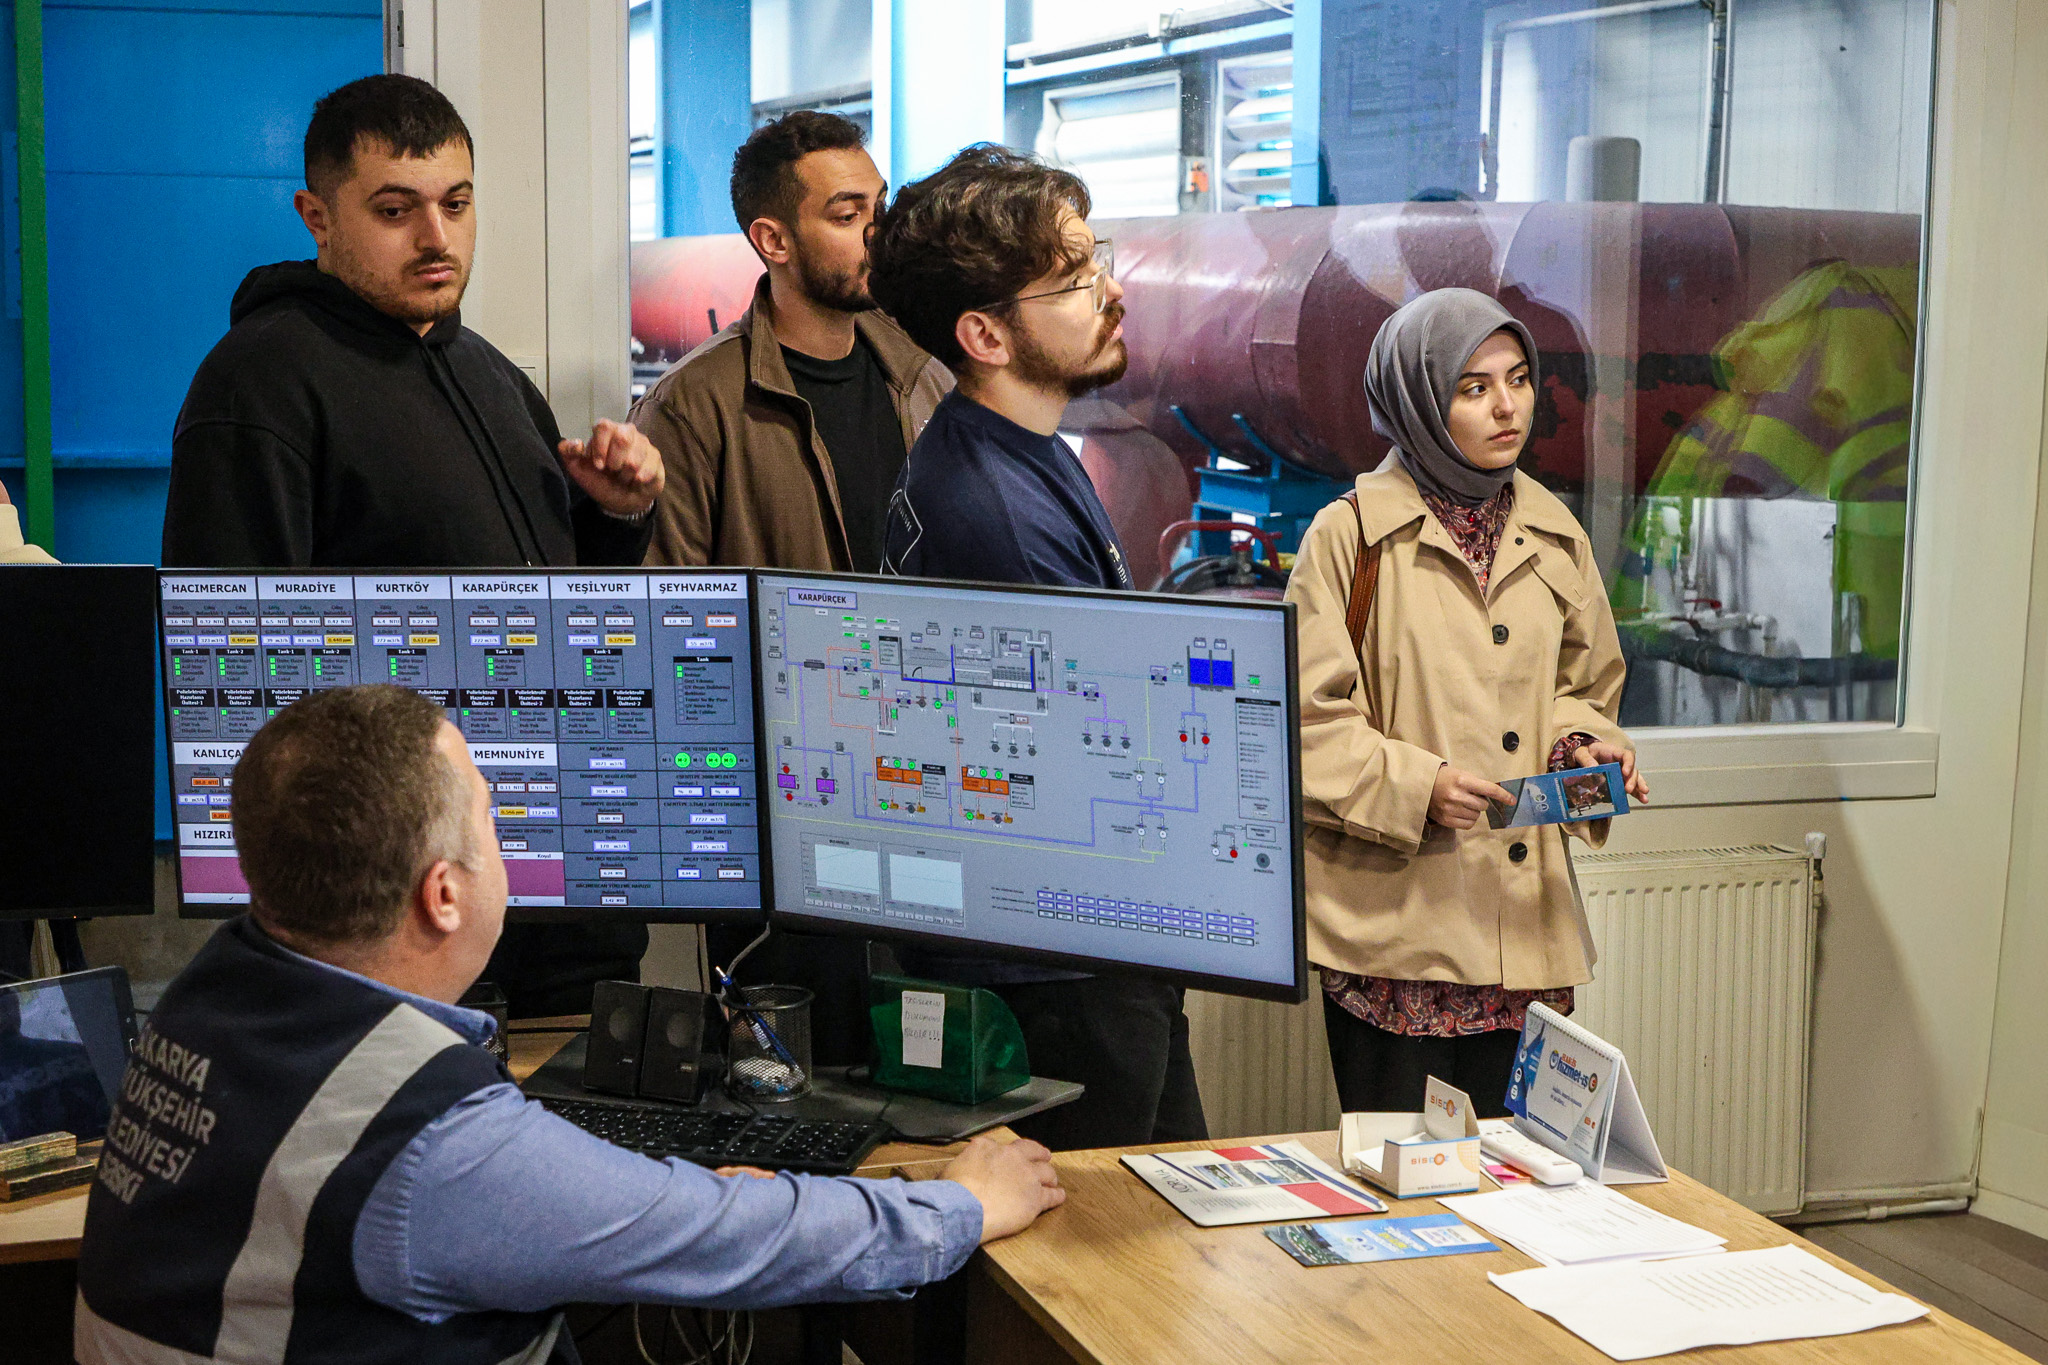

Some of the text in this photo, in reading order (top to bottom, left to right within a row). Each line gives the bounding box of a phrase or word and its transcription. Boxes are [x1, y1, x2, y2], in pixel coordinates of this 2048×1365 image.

[172, 584, 247, 593] HACIMERCAN
[275, 581, 336, 593] MURADİYE
[376, 581, 429, 593] KURTKÖY
[462, 581, 539, 595] KARAPÜRÇEK
[566, 580, 631, 595] YEŞİLYURT
[659, 583, 738, 595] ŞEYHVARMAZ
[797, 592, 847, 605] KARAPÜRÇEK
[474, 748, 545, 759] MEMNUNİYE
[194, 830, 235, 840] HIZIRI
